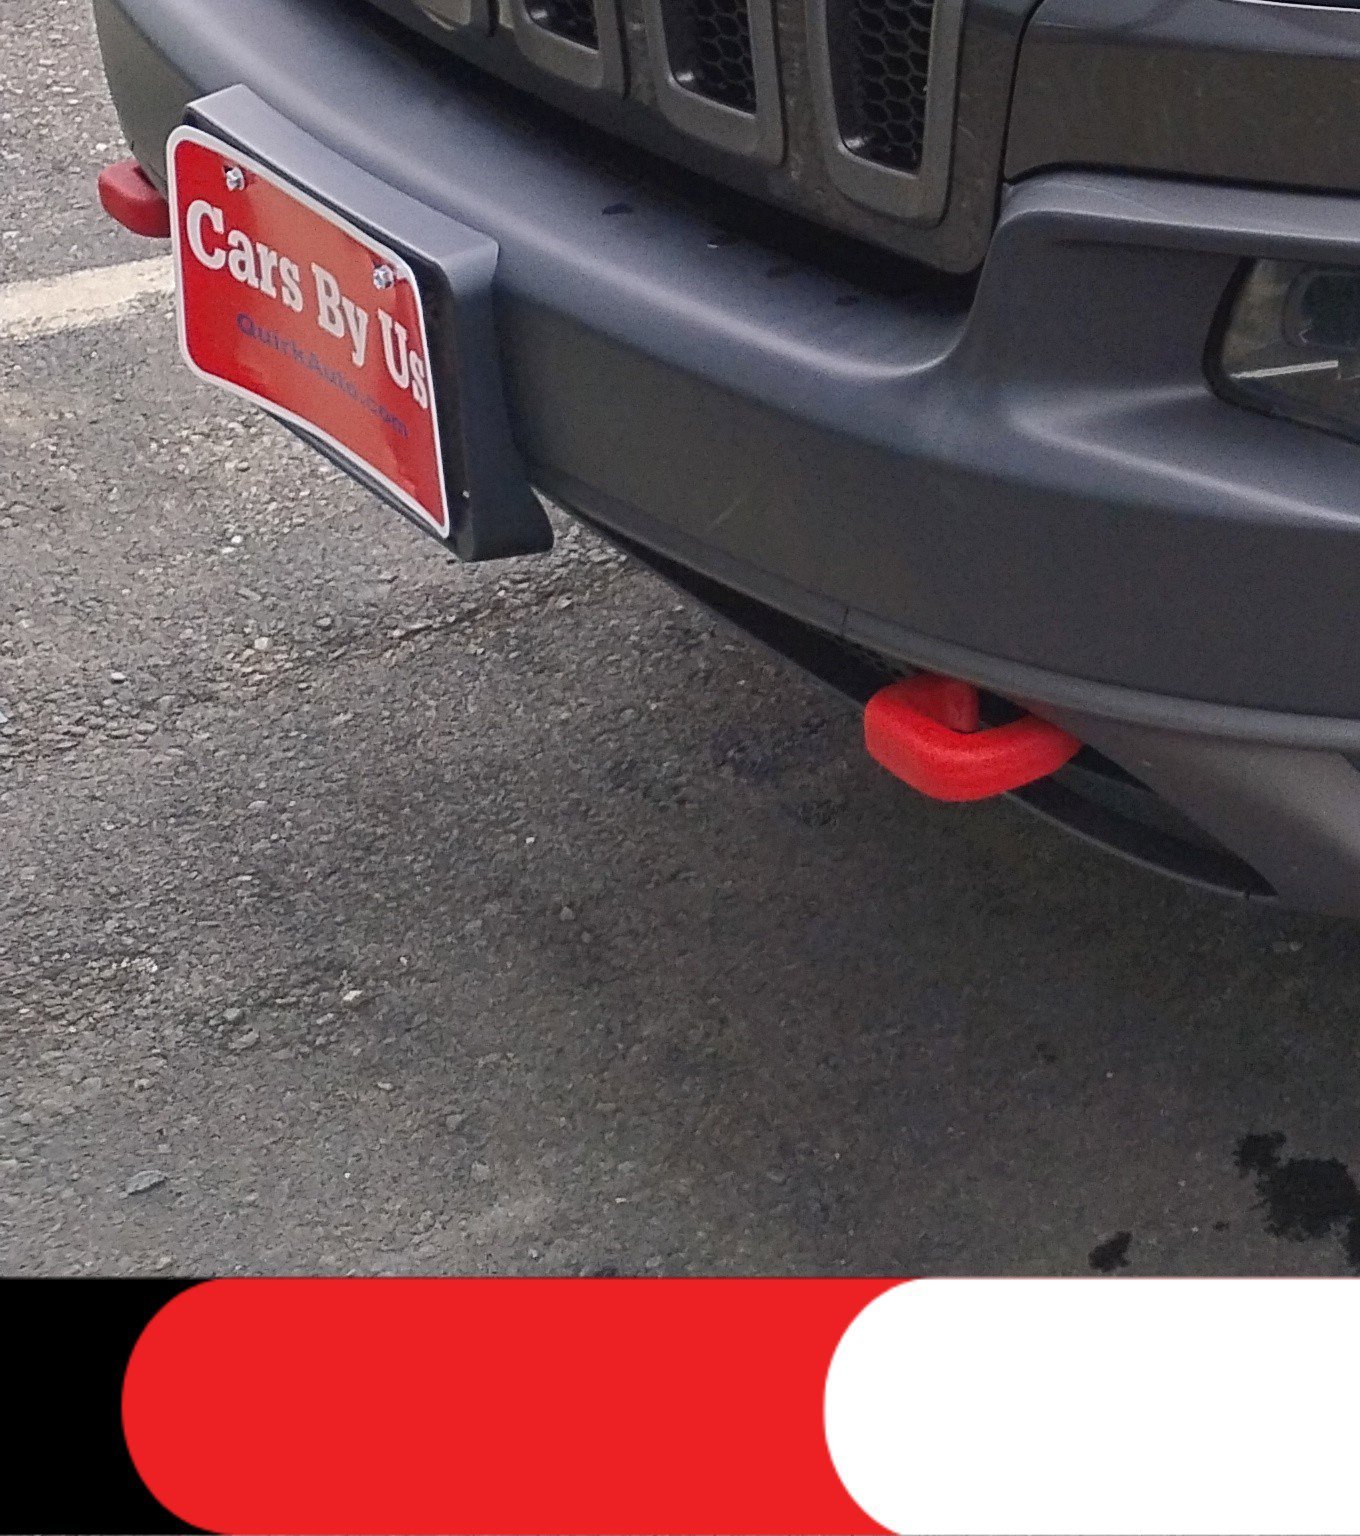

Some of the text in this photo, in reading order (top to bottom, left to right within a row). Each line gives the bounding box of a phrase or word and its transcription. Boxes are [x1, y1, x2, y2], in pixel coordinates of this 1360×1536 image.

[185, 199, 430, 410] Cars By Us
